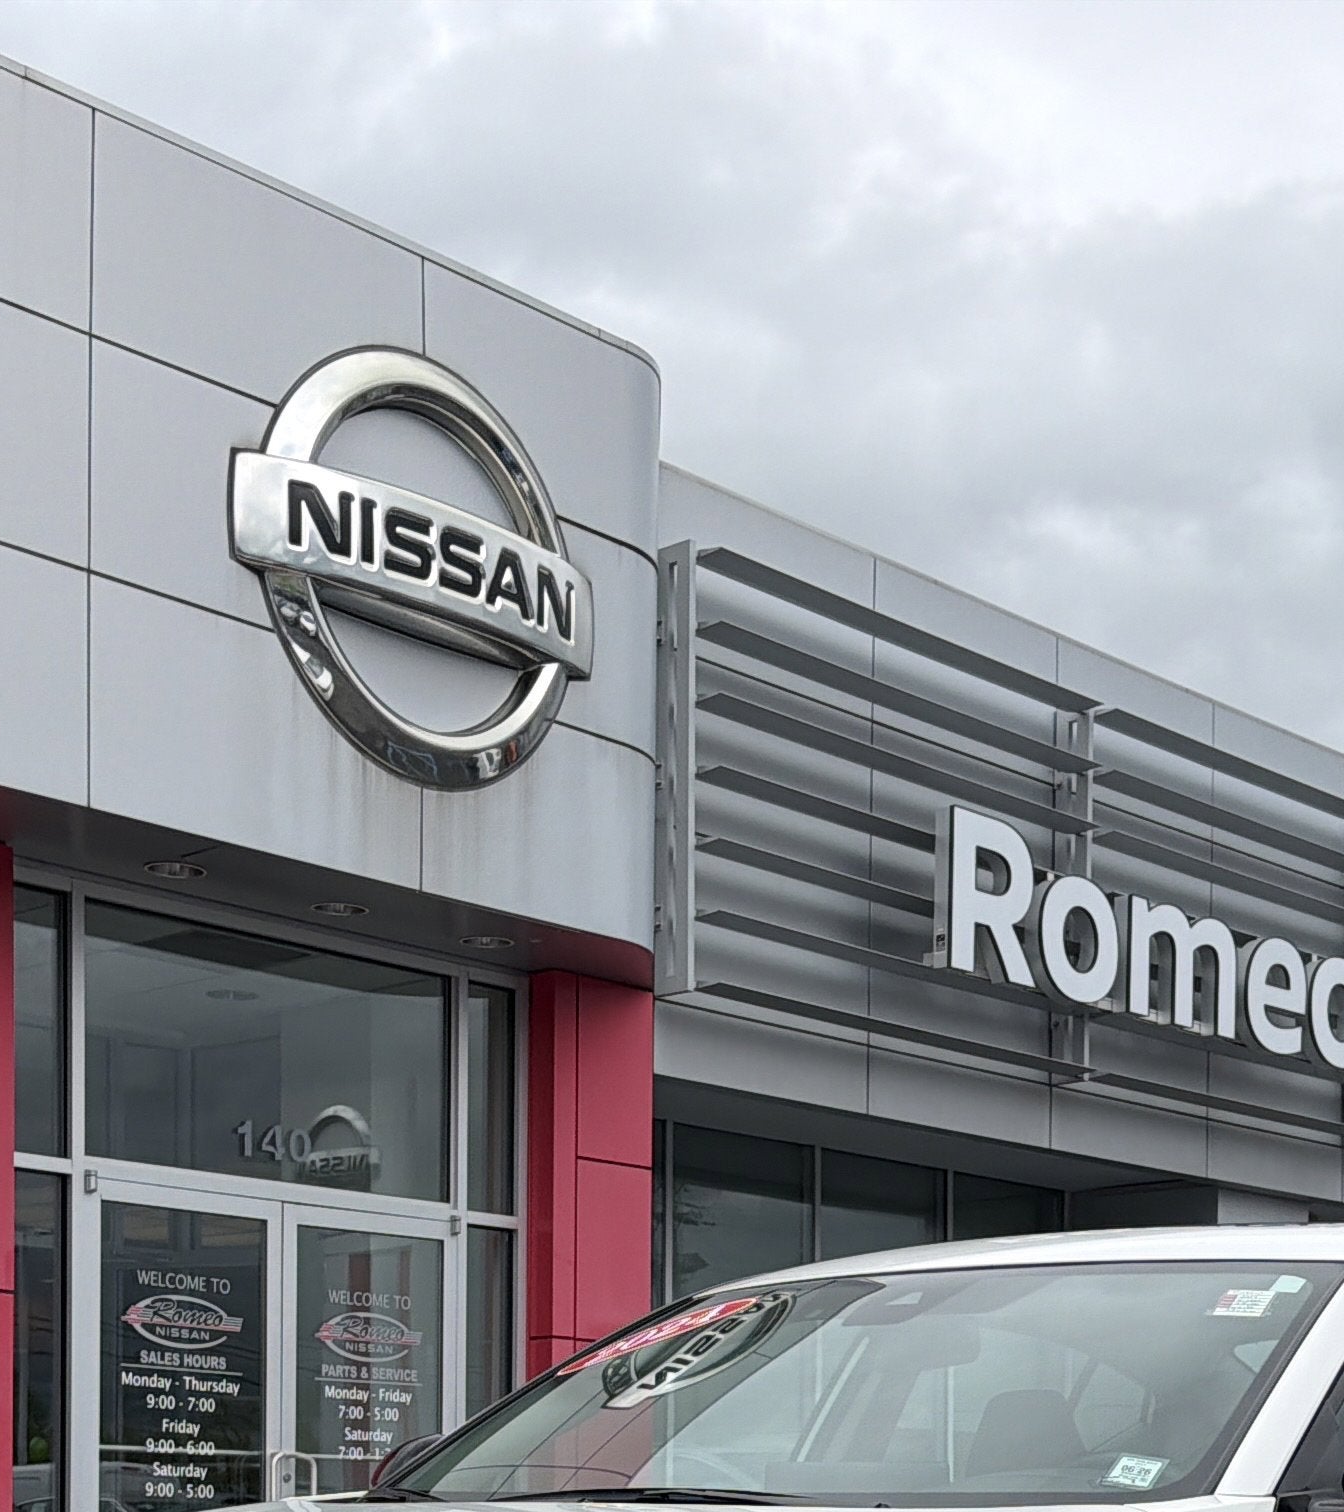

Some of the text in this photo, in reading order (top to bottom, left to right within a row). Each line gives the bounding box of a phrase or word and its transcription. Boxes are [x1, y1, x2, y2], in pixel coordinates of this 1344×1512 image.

[287, 479, 575, 645] NISSAN
[237, 1119, 311, 1163] 140
[137, 1269, 231, 1295] WELCOME TO
[328, 1289, 411, 1310] WELCOME TO
[149, 1298, 224, 1327] Romeo
[155, 1326, 210, 1341] NISSAN
[337, 1315, 405, 1341] Romeo
[345, 1342, 393, 1354] NISSAN
[139, 1349, 227, 1370] SALES HOURS
[321, 1364, 417, 1382] PARTS & SERVICE
[121, 1371, 172, 1392] Monday
[182, 1376, 241, 1397] Thursday
[146, 1394, 176, 1410] 9:00
[187, 1397, 216, 1413] 7:00
[324, 1385, 369, 1403] Monday
[378, 1388, 412, 1406] Friday
[338, 1405, 364, 1419] 7:00
[374, 1407, 399, 1421] 5:00
[162, 1418, 201, 1437] Friday
[344, 1427, 393, 1444] Saturday
[146, 1438, 175, 1454] 9:00
[186, 1440, 215, 1456] 6:00
[338, 1446, 364, 1460] 7:00
[153, 1462, 208, 1481] Saturday
[145, 1482, 174, 1497] 9:00
[186, 1484, 214, 1499] 5:00
